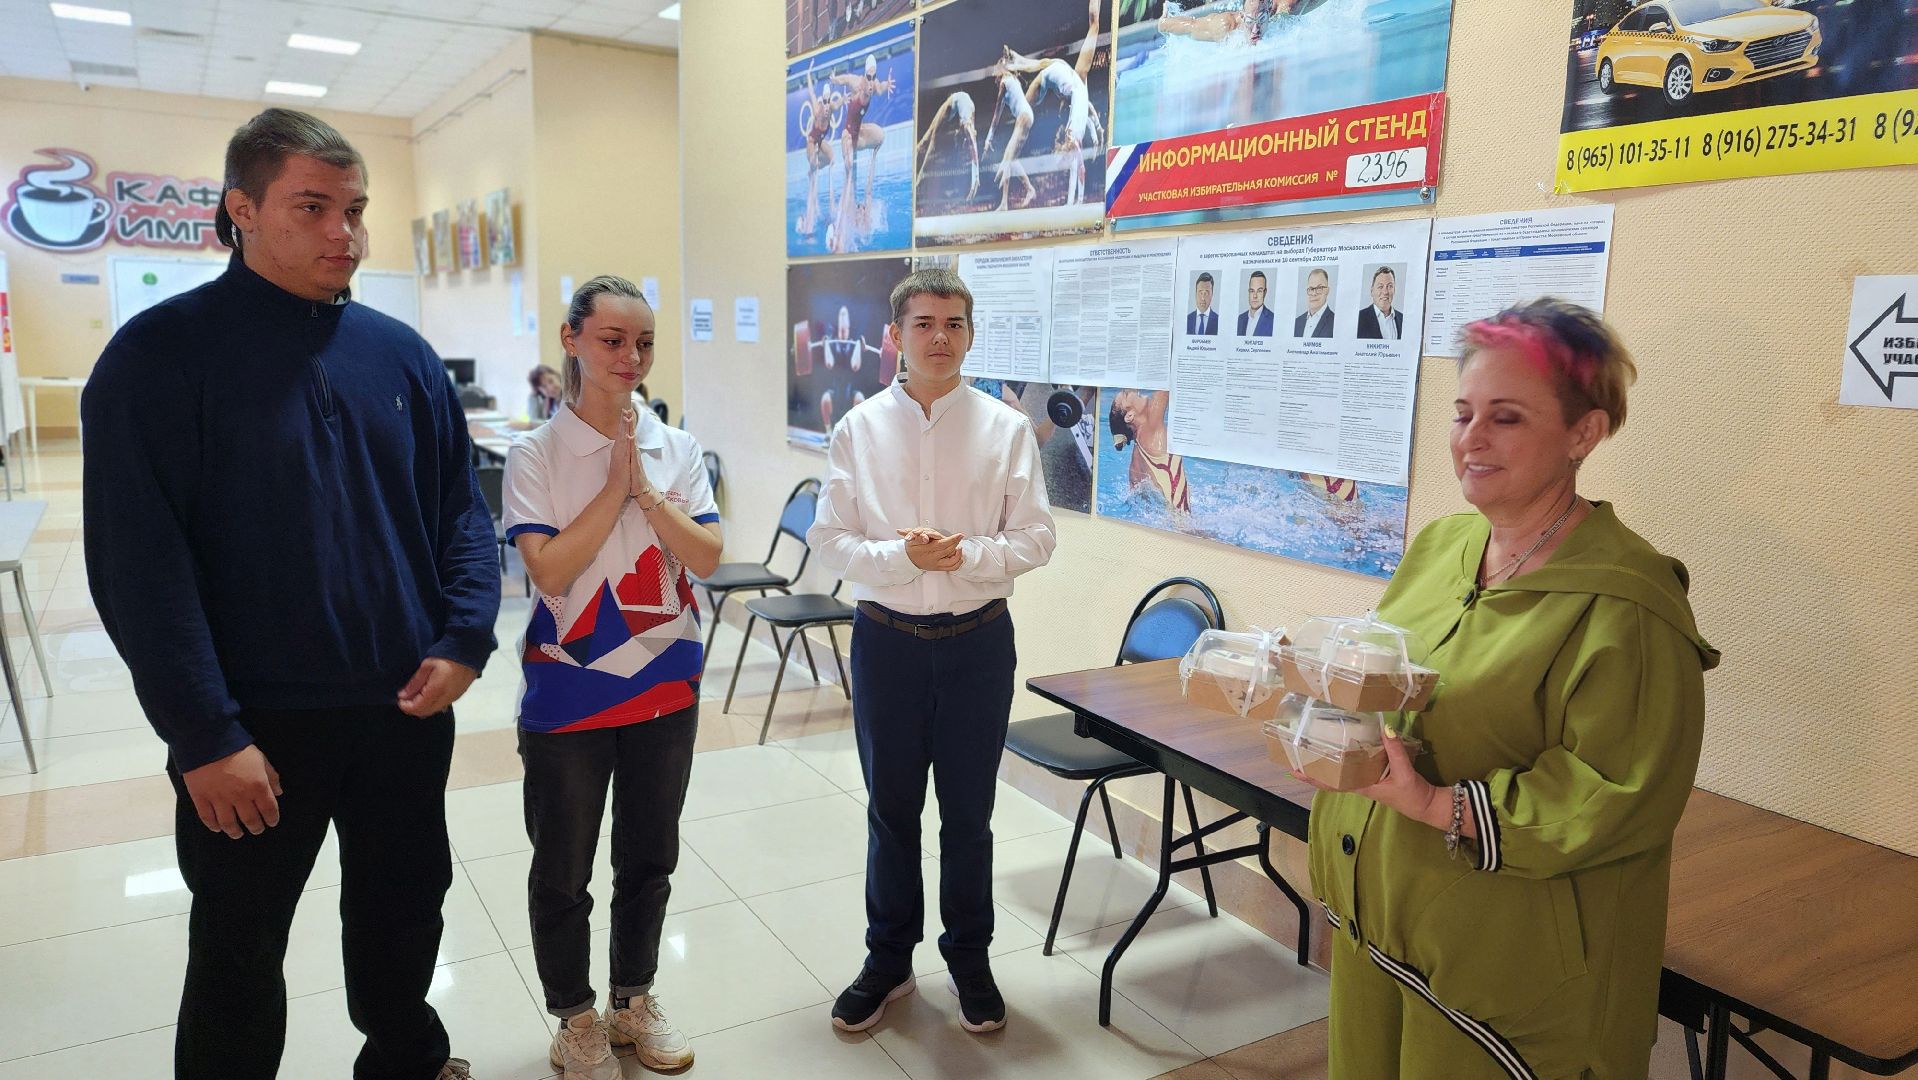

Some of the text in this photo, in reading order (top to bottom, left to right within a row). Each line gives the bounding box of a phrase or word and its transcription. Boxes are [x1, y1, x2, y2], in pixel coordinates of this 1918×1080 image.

[1139, 109, 1427, 173] ИНФОРМАЦИОННЫЙ СТЕНД
[1619, 135, 1691, 165] 101-35-11
[1766, 116, 1857, 150] 275-34-31
[1357, 149, 1410, 184] 2396
[1138, 187, 1189, 203] УЧАСТКОВАЯ
[1190, 179, 1263, 197] ИЗБИРАТЕЛЬНАЯ
[1263, 172, 1319, 188] КОМИССИЯ
[1267, 234, 1314, 248] СВЕДЕНИЯ
[1882, 336, 1918, 349] ИЗБ
